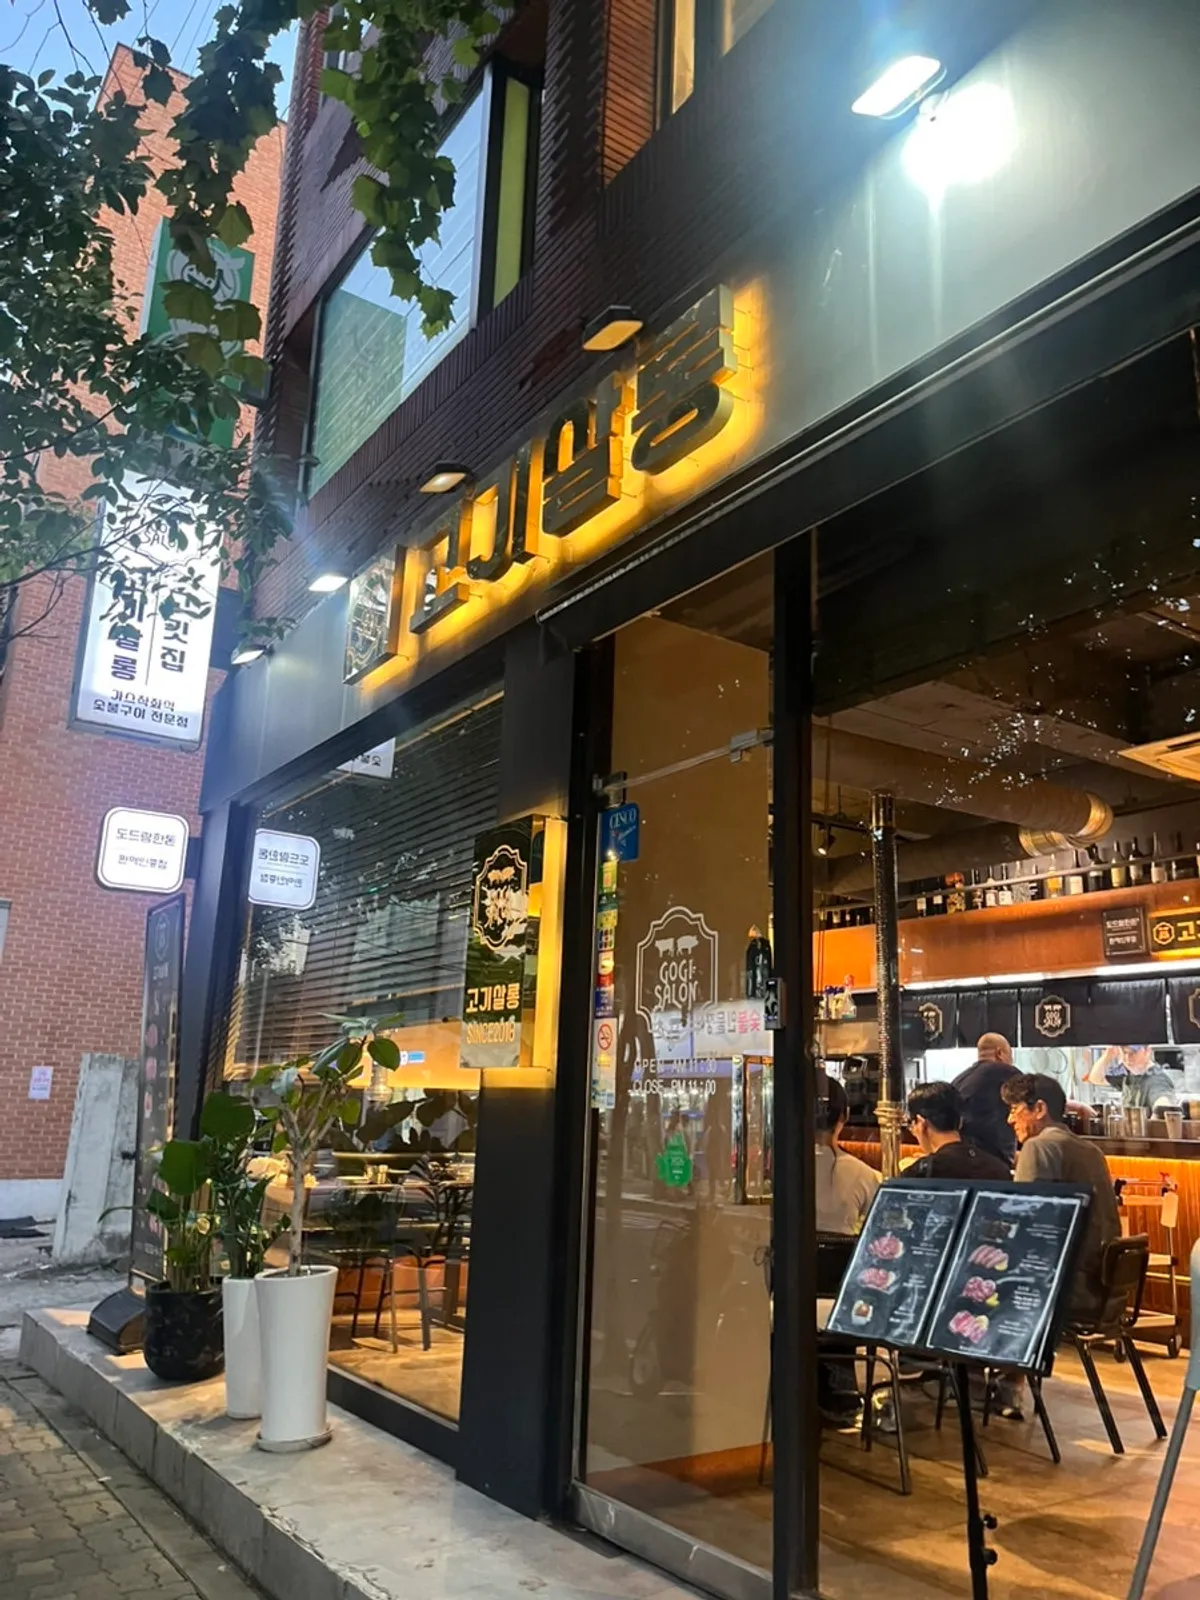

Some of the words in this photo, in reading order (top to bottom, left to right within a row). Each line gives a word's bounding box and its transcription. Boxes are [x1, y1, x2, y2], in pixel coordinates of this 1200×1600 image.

[410, 283, 738, 635] 고기살롱
[141, 530, 179, 553] SAL
[151, 709, 189, 729] 전문점
[116, 828, 176, 847] 도드람한돈
[1177, 920, 1200, 942] 고
[660, 959, 694, 984] GOGI
[466, 982, 520, 1013] 고기살롱
[654, 980, 698, 1011] SALON
